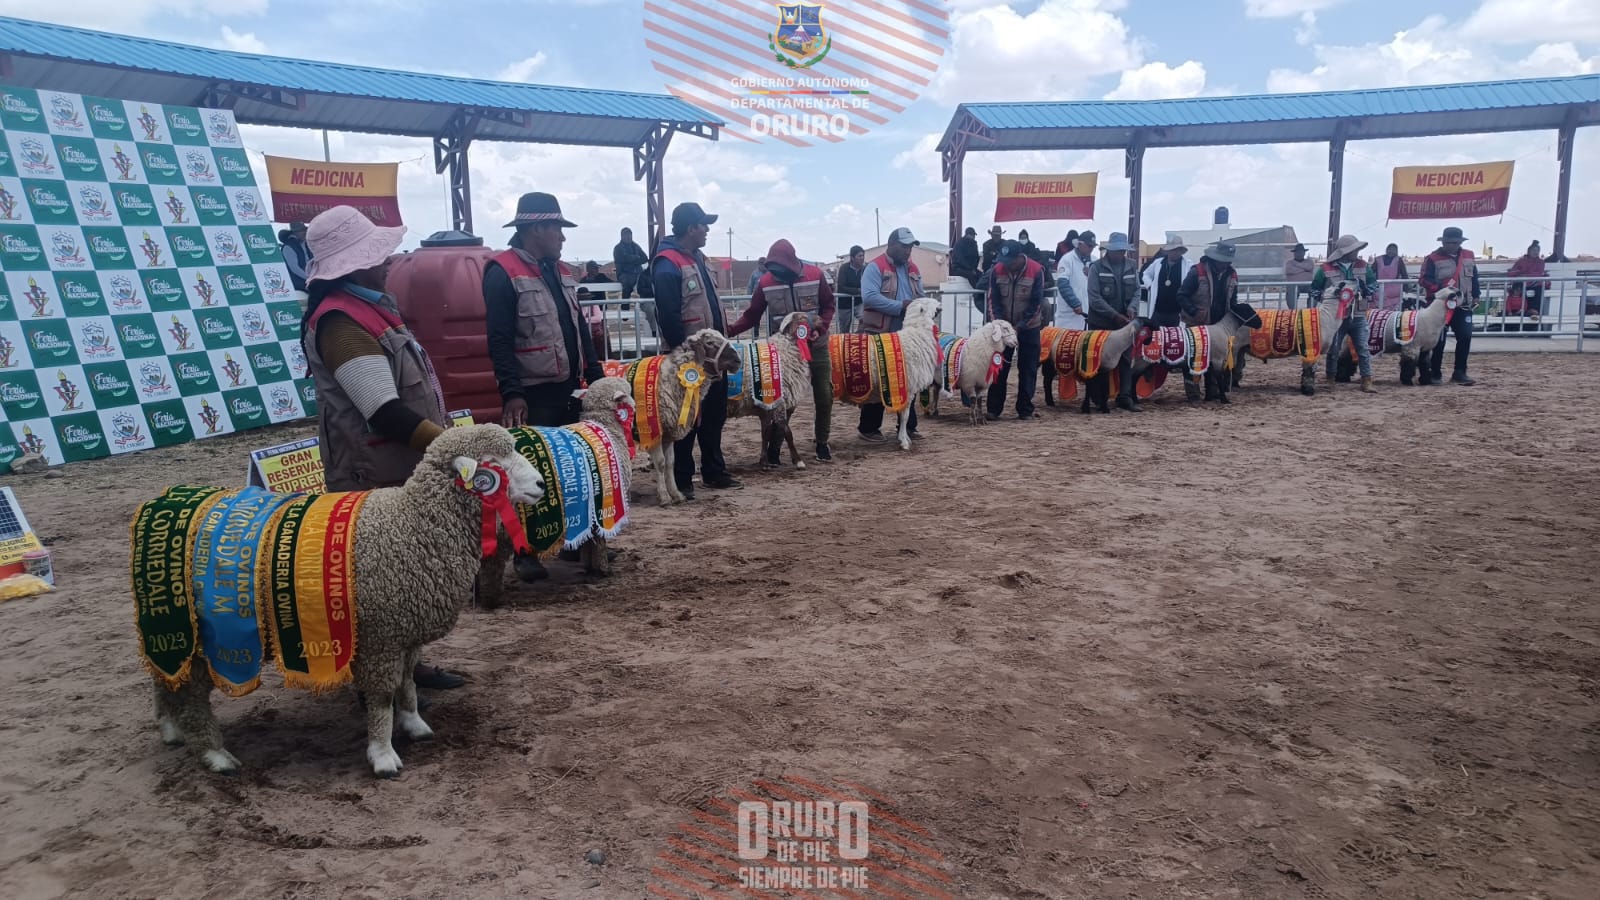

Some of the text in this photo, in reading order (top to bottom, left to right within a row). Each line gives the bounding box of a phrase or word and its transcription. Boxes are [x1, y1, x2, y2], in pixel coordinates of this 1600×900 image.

[291, 168, 365, 188] MEDICINA
[1415, 170, 1484, 187] MEDICINA
[1014, 181, 1073, 194] INGENIERIA
[65, 281, 88, 293] Feria
[150, 278, 170, 289] Feria
[123, 324, 145, 336] Feria
[203, 318, 224, 328] Feria
[34, 331, 58, 342] Feria
[255, 353, 274, 363] Feria
[179, 362, 200, 373] Feria
[95, 372, 118, 383] Feria
[97, 381, 130, 390] NACIONAL
[1, 382, 26, 394] Feria
[4, 391, 40, 402] NACIONAL
[234, 397, 253, 408] Feria
[646, 384, 654, 417] OVINOS
[153, 411, 175, 422] Feria
[156, 418, 187, 428] NACIONAL
[65, 425, 90, 436] Feria
[68, 433, 102, 443] NACIONAL
[281, 449, 313, 466] GRAN
[598, 430, 619, 489] DE OVINOS
[267, 459, 325, 484] RESERVAD
[535, 442, 546, 461] DE
[542, 460, 558, 507] OVINOS
[558, 446, 579, 494] CORRIEDALE
[570, 440, 589, 501] DE OVINOS
[274, 472, 326, 493] SUPREM
[593, 472, 601, 496] OVINA
[174, 508, 191, 530] DE
[565, 514, 581, 528] 023
[599, 505, 616, 520] 2023
[535, 521, 559, 540] 2023
[194, 511, 224, 577] GANADERIA
[133, 506, 153, 616] GANADERIA OVINA
[146, 508, 175, 618] CORRIEDALE
[276, 508, 303, 629] LA GANADERIA OVINA
[168, 536, 187, 609] OVINOS
[329, 522, 345, 621] DE OVINOS
[236, 545, 253, 620] OVINOS
[149, 632, 188, 653] 2023
[297, 640, 343, 658] 2023
